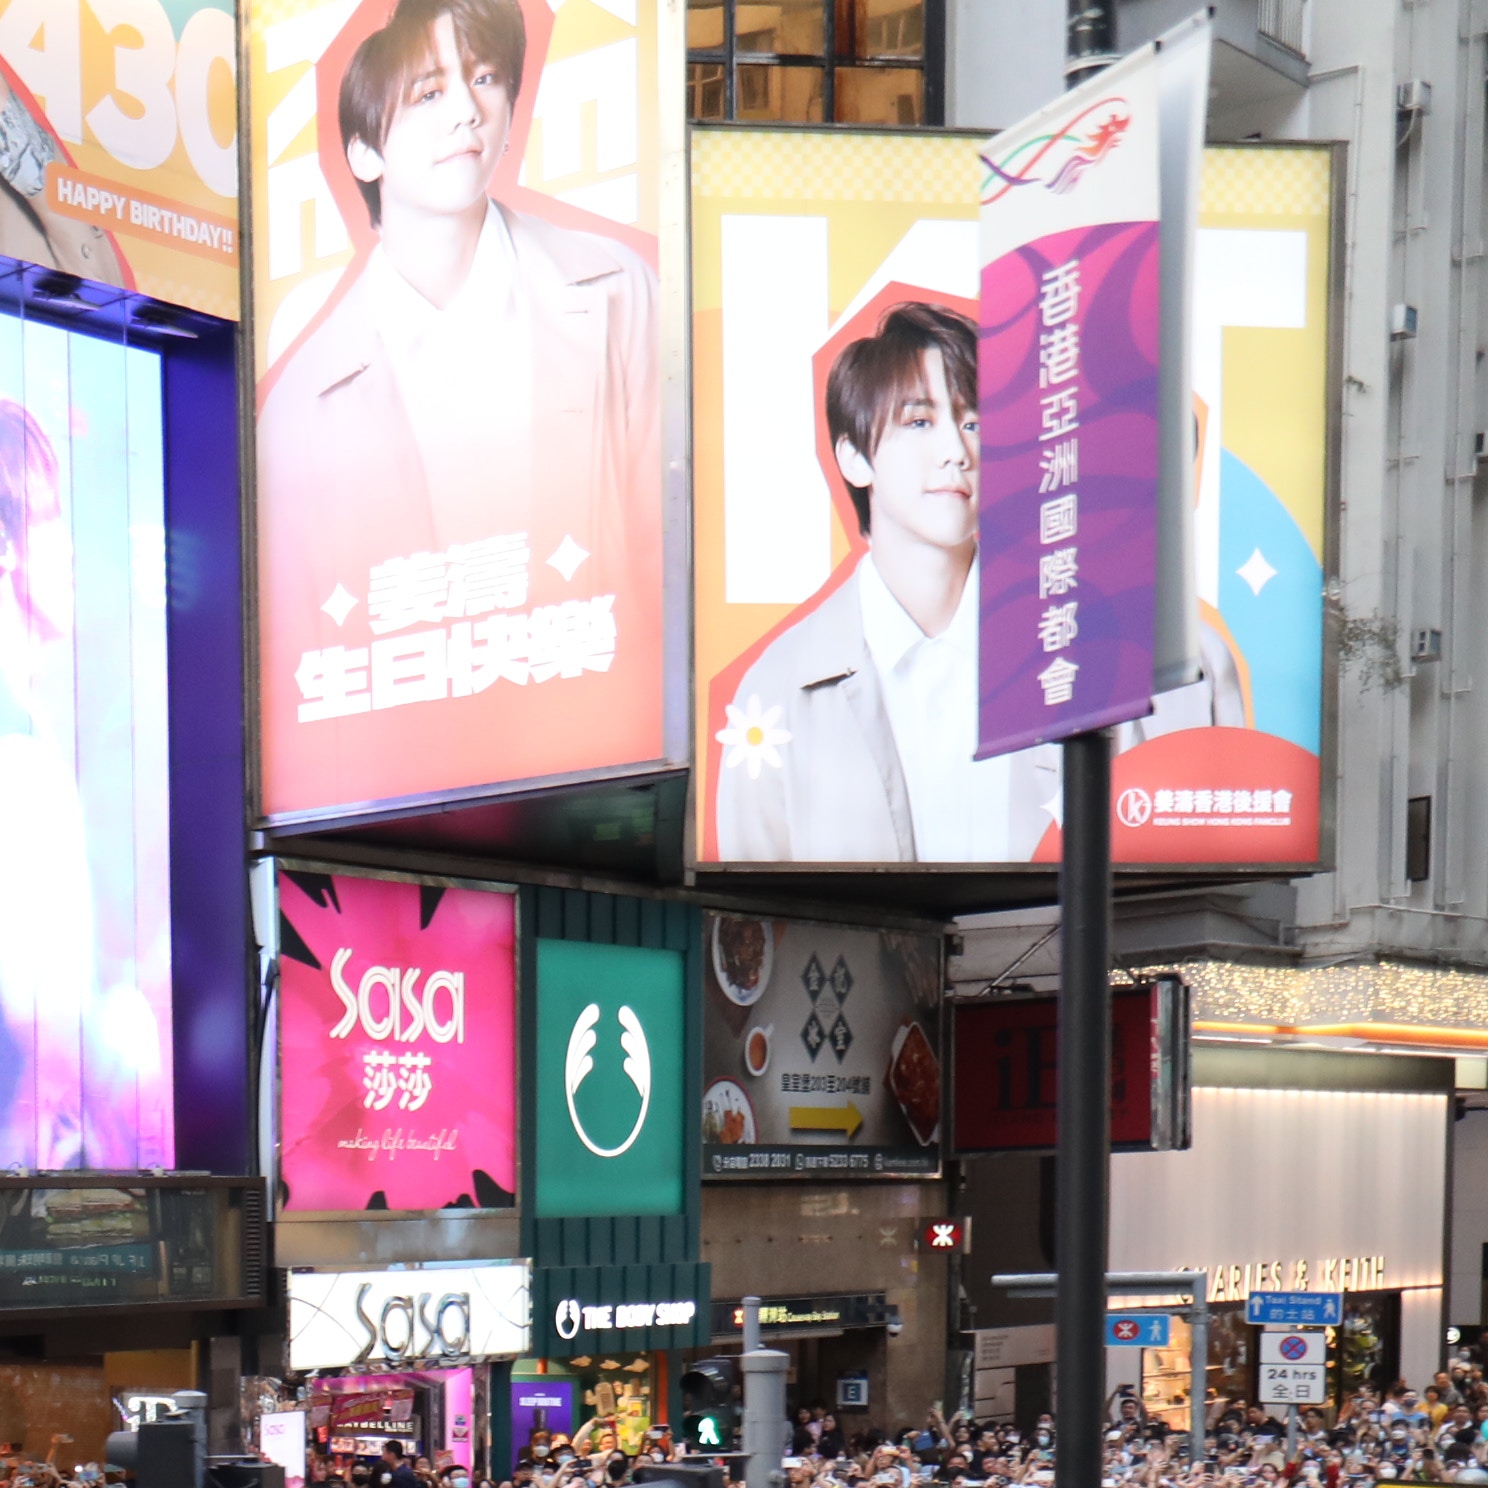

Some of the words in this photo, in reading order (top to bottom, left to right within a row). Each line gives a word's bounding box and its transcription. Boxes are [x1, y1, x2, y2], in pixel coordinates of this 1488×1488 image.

[57, 177, 126, 221] HAPPY
[129, 203, 234, 254] BIRTHDAY!!
[1036, 257, 1082, 708] 香港亞洲國際都會
[367, 531, 530, 637] 姜濤
[293, 592, 619, 724] 生日快樂
[1154, 788, 1293, 814] 姜濤香港後援會
[362, 1050, 433, 1113] 莎莎
[1323, 1256, 1384, 1293] KEITH
[581, 1304, 614, 1331] THE
[615, 1302, 655, 1329] BODY
[655, 1300, 696, 1327] SHOP
[1269, 1307, 1316, 1322] 的士站
[1288, 1295, 1323, 1306] Stand
[1267, 1368, 1290, 1381] 24
[1292, 1366, 1318, 1381] hrs
[847, 1385, 858, 1400] E
[1272, 1383, 1312, 1401] 全日
